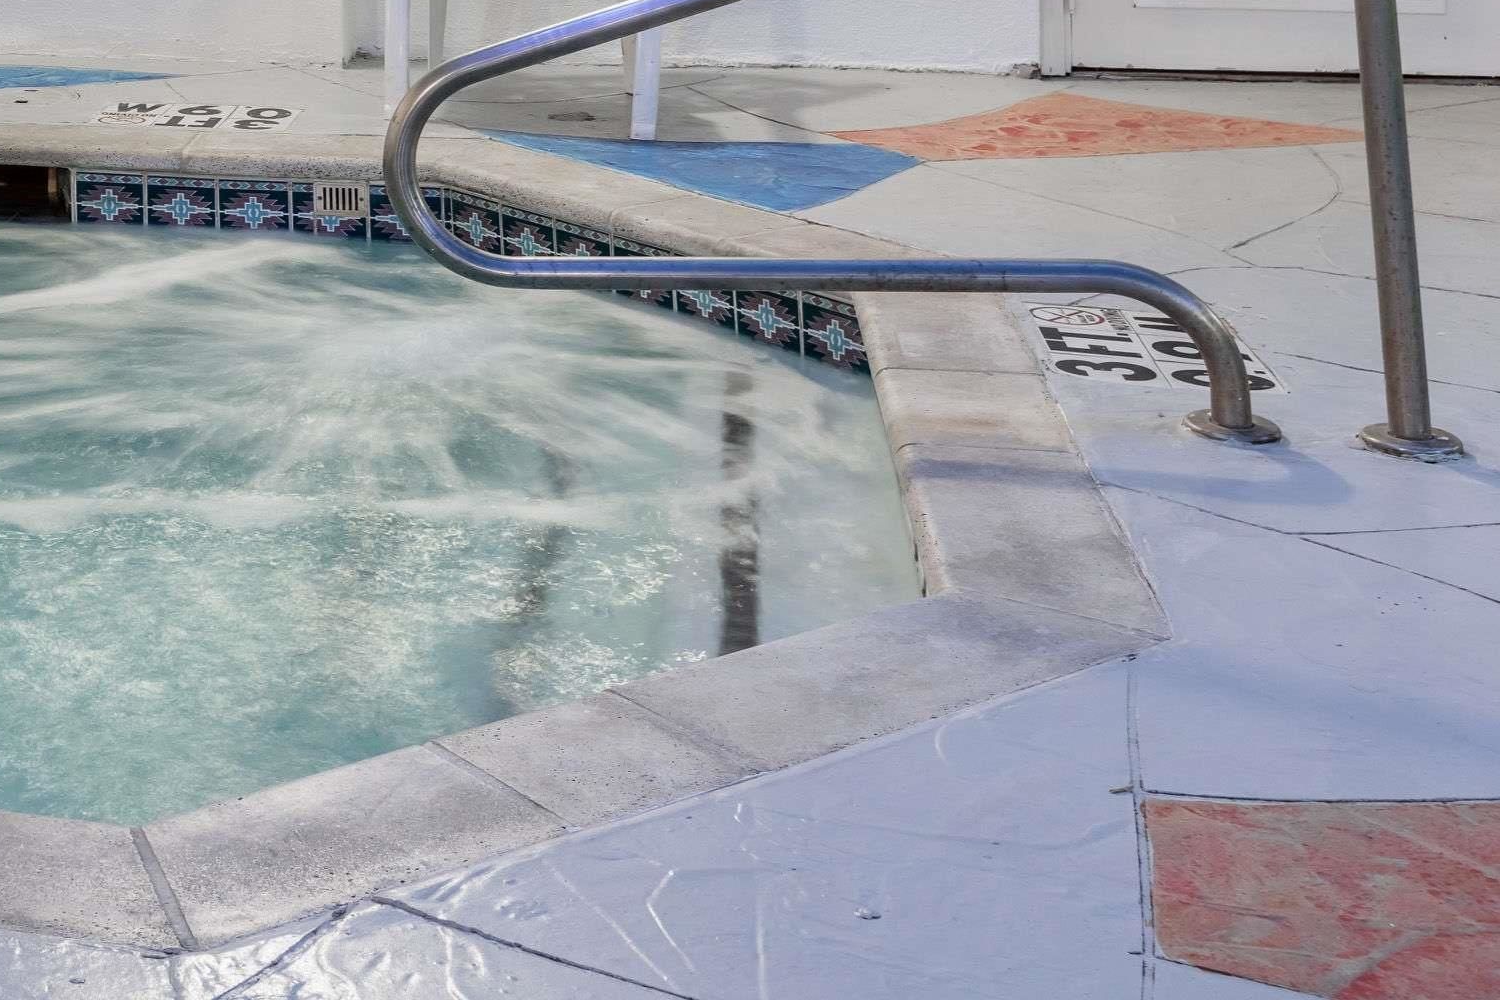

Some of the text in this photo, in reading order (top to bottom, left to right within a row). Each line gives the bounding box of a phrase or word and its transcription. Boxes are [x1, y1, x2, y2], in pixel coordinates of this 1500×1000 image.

[118, 102, 166, 113] M
[233, 119, 280, 130] 3
[1054, 359, 1157, 381] 3
